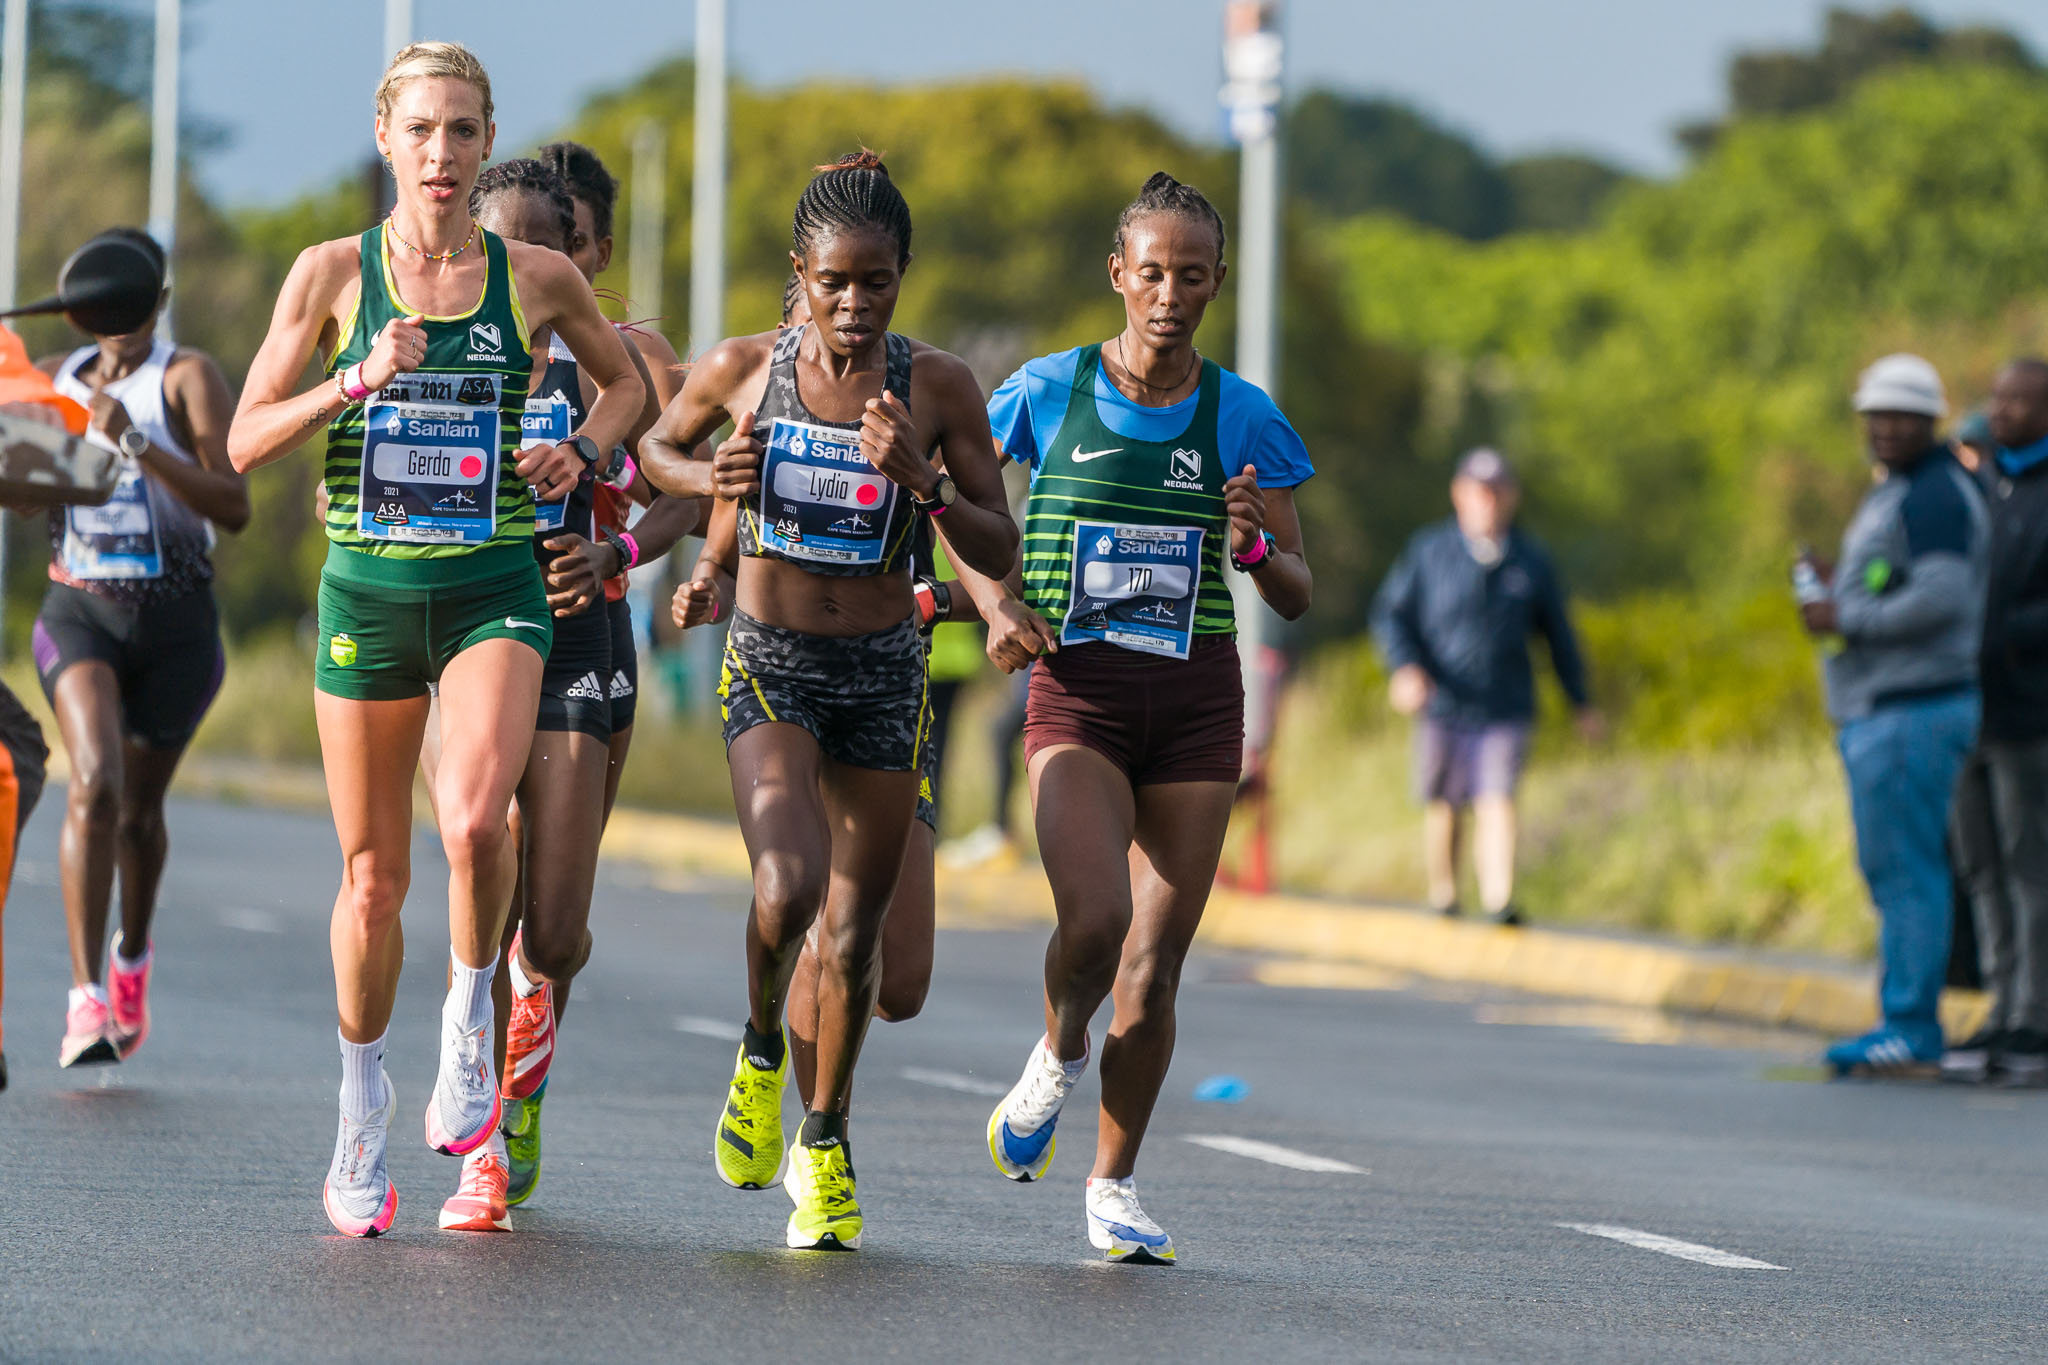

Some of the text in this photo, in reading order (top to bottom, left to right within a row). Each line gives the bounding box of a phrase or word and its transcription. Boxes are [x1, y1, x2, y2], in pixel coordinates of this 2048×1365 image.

[466, 353, 507, 363] NEDBANK
[420, 382, 452, 400] 2021
[462, 380, 493, 394] ASA
[407, 420, 480, 438] Sanlam
[408, 449, 451, 477] Gerda
[383, 486, 399, 496] 2021
[810, 471, 849, 502] Lydia
[1163, 479, 1204, 491] NEDBANK
[377, 502, 406, 517] ASA
[783, 503, 797, 515] 2021
[776, 517, 800, 535] ASA
[1118, 538, 1187, 557] Sanlam
[1128, 567, 1153, 593] 170
[567, 687, 603, 702] adidas
